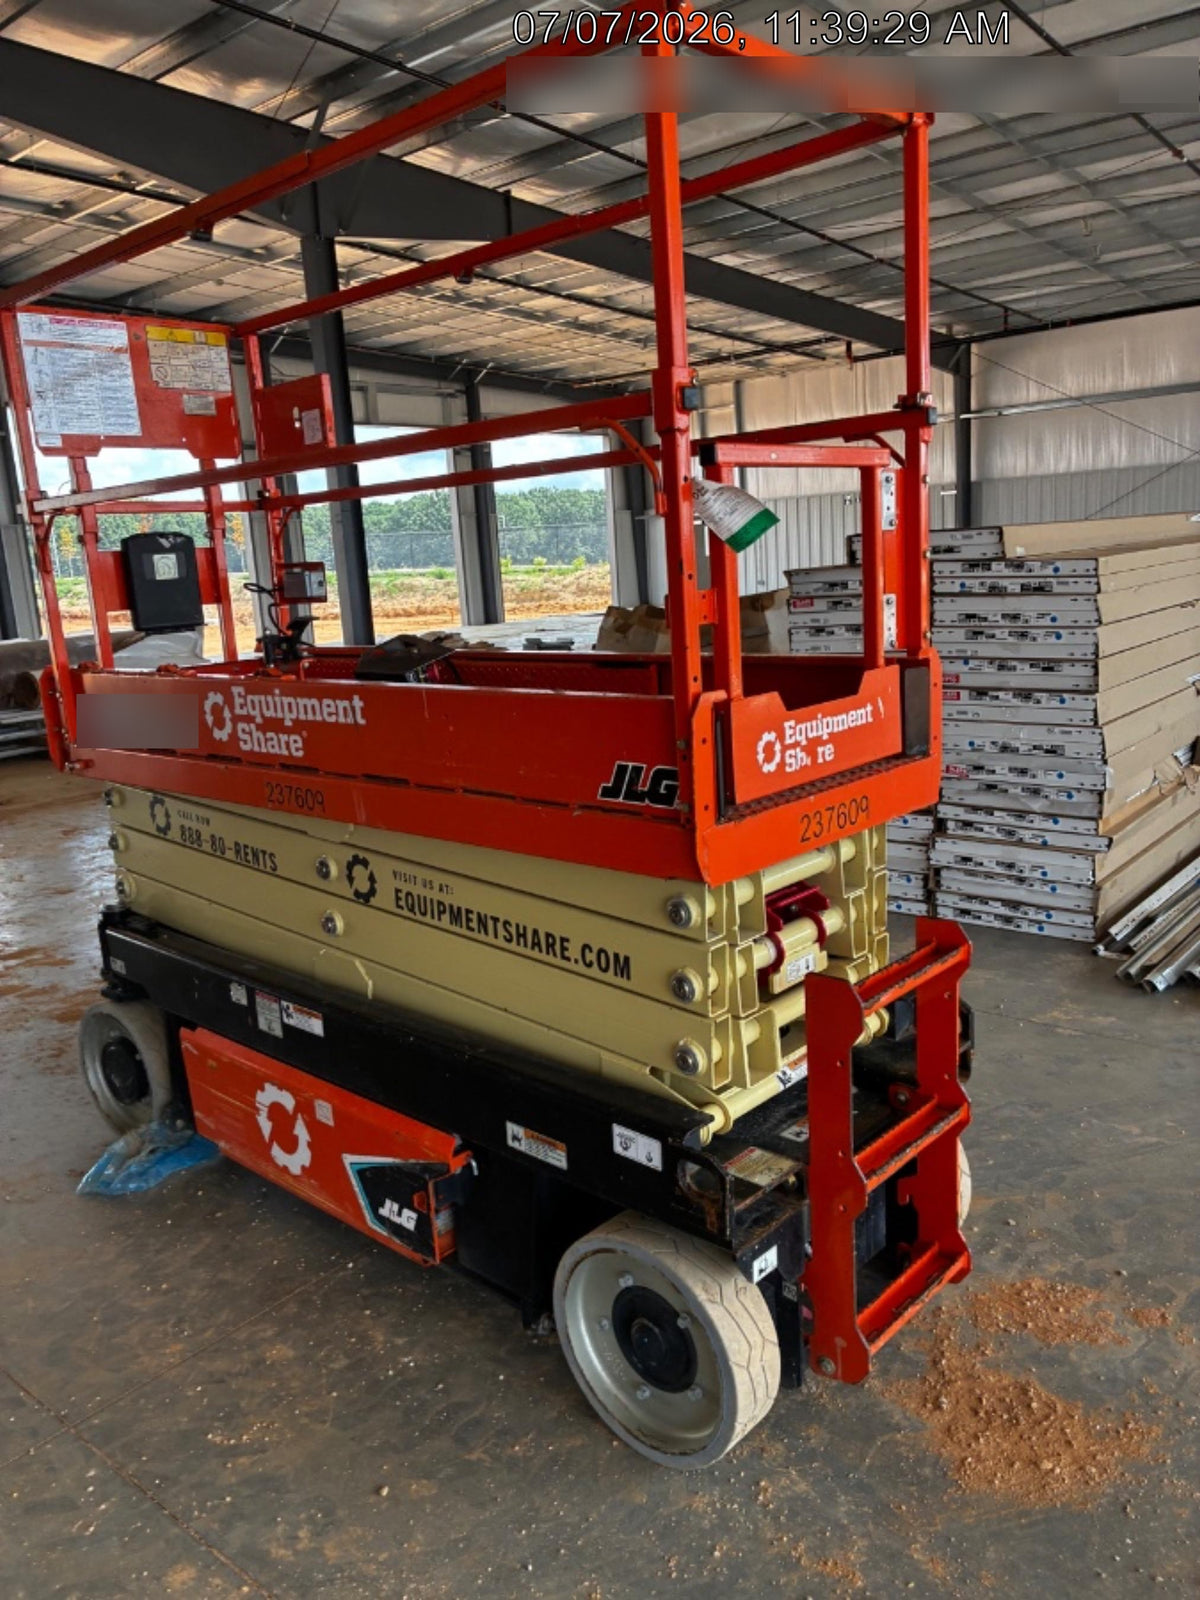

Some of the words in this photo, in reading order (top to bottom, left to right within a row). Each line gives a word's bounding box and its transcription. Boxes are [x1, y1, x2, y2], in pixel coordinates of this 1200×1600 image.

[231, 685, 367, 727] Equipment
[783, 702, 873, 746] Equipment
[237, 723, 304, 758] Share
[784, 743, 836, 773] Shre
[265, 781, 326, 814] 237609
[597, 760, 680, 809] JLG
[800, 795, 870, 843] 237609
[179, 823, 279, 873] 888-80-RENTS
[392, 869, 418, 887] VISIT
[422, 877, 435, 891] US
[394, 886, 632, 982] EQUIPMENTSHARE.COM
[378, 1198, 418, 1232] JLG
